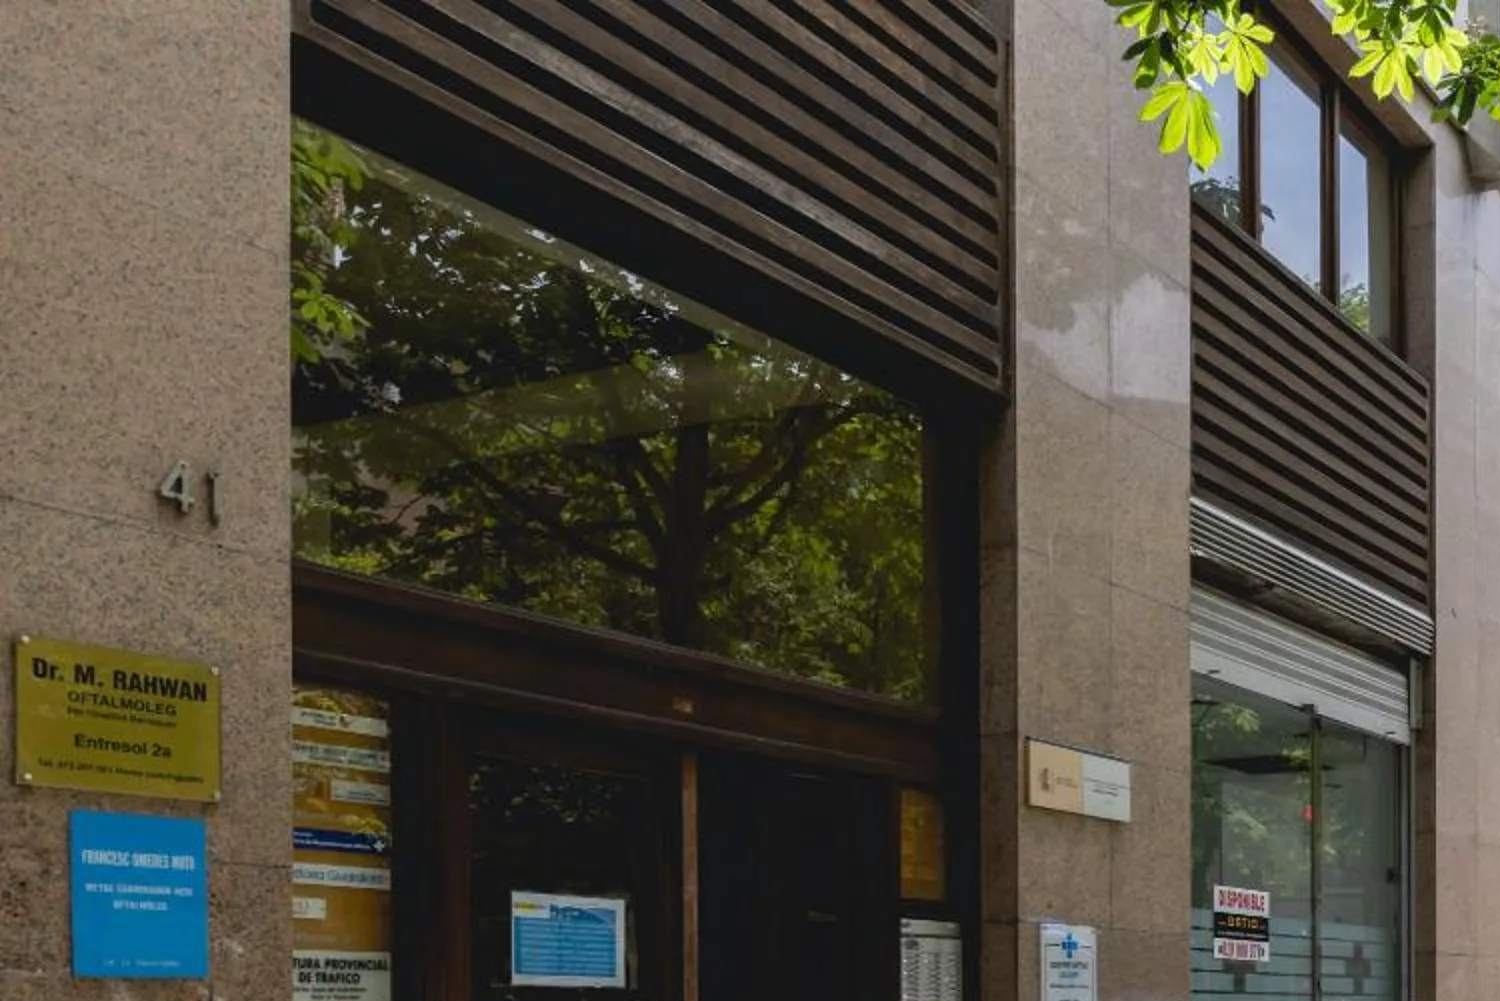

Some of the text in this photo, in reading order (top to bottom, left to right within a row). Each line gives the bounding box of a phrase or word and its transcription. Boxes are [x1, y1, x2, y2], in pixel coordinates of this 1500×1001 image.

[159, 460, 222, 520] 41
[31, 657, 208, 703] Dr. M. RAHWAN
[73, 732, 148, 756] Entresol
[324, 957, 388, 972] PROVINCIAL
[298, 971, 312, 984] DE
